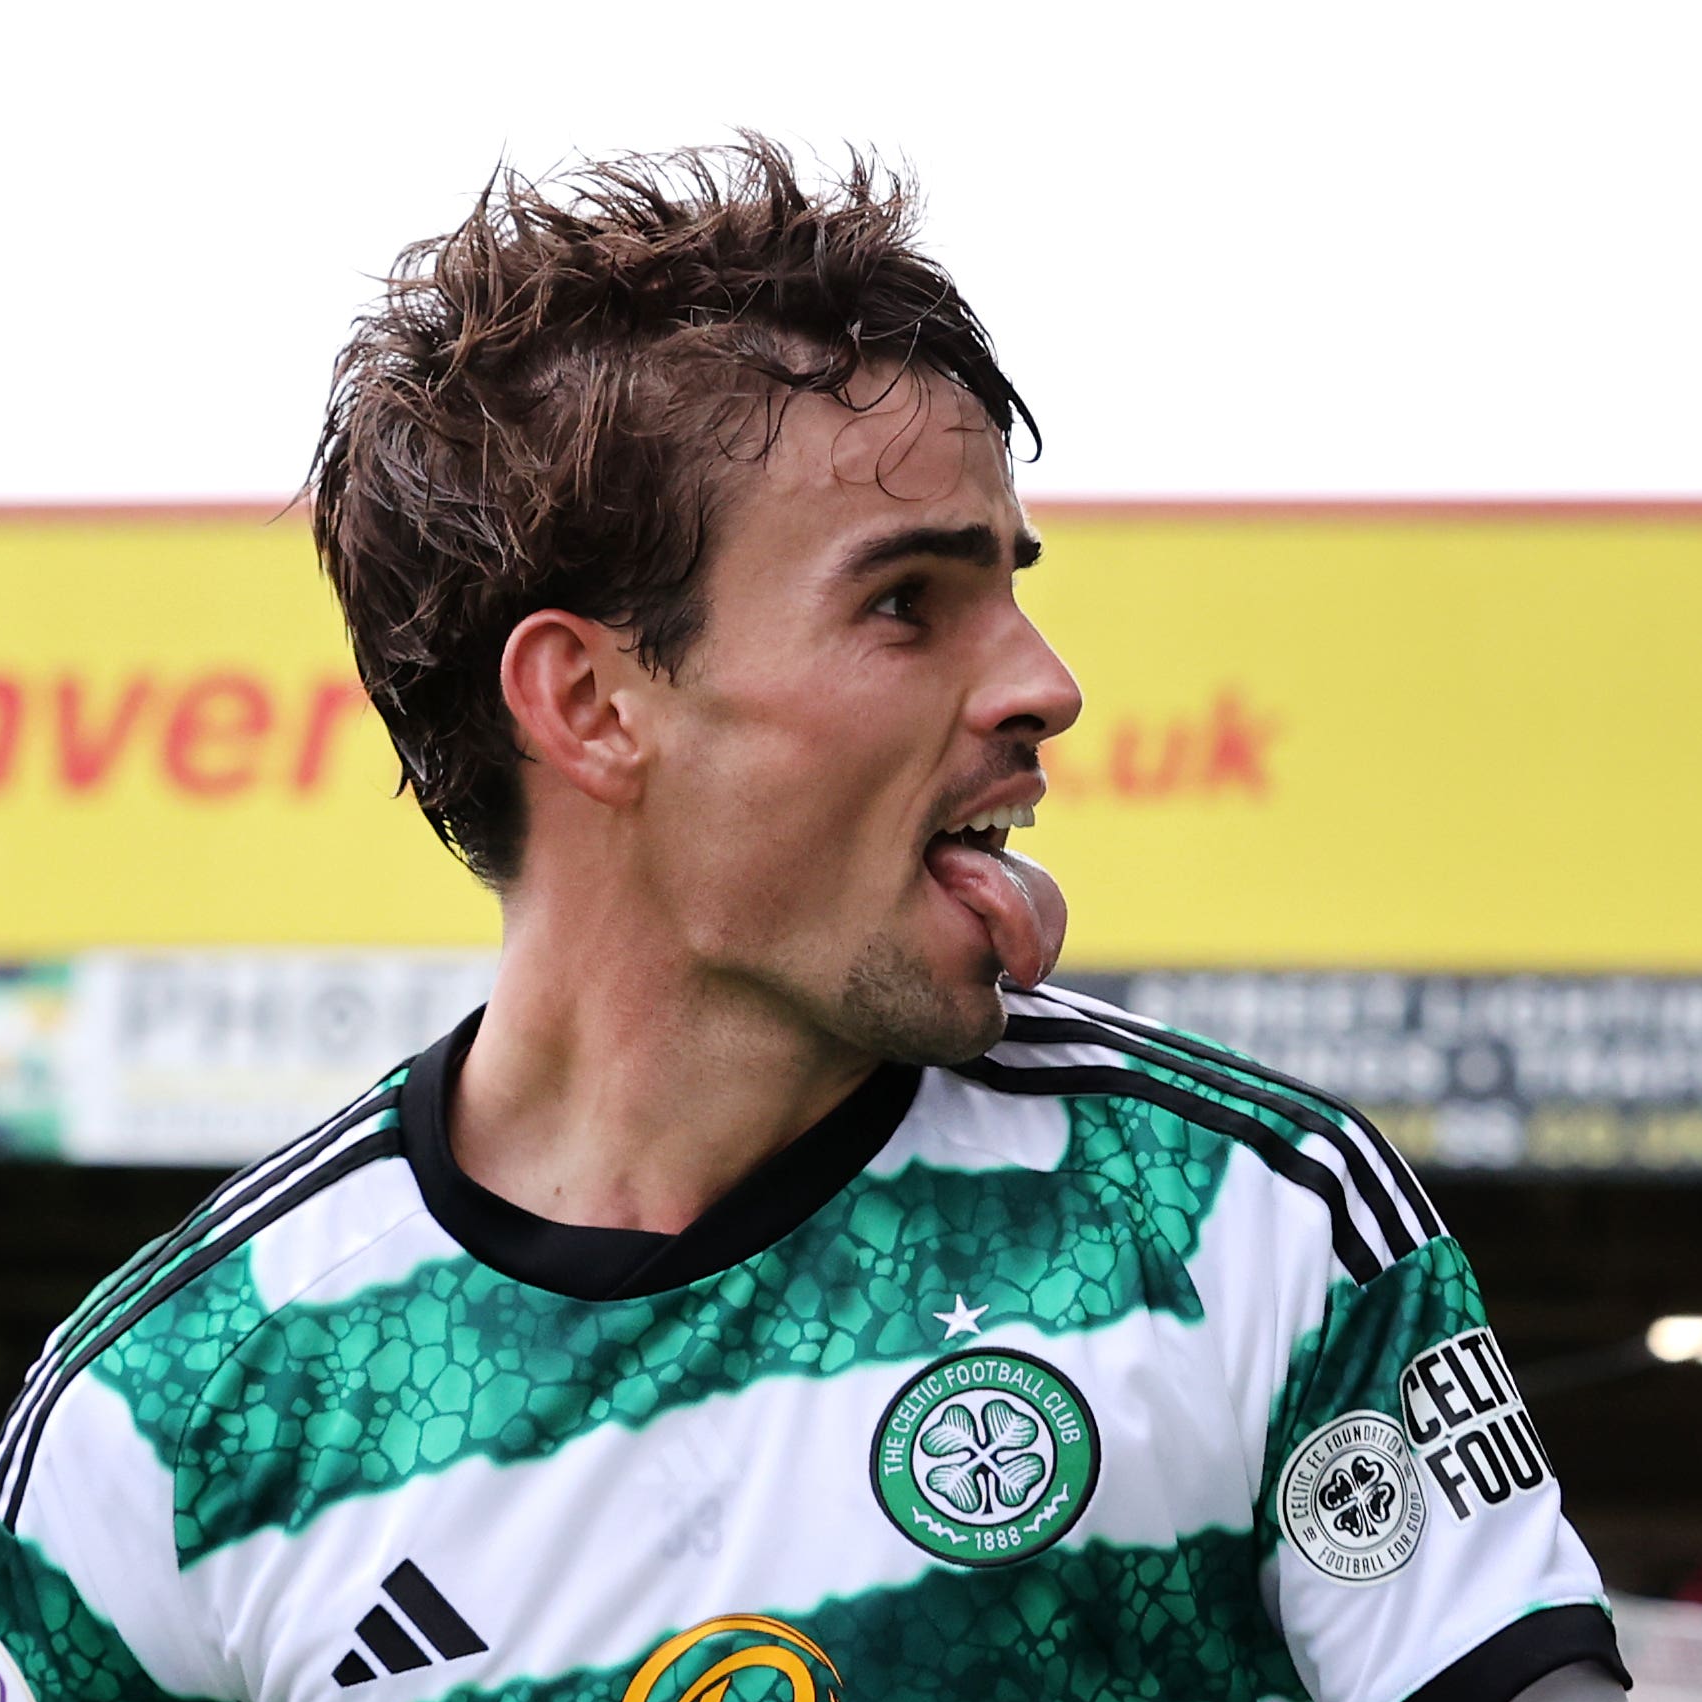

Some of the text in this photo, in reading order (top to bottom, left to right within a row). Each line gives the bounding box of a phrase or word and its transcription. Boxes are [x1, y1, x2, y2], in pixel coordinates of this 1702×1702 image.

[884, 1361, 1082, 1477] THE CELTIC FOOTBALL CLUB
[1291, 1472, 1314, 1520] CELTIC
[1306, 1450, 1326, 1470] FC
[975, 1525, 1022, 1552] 1888
[1318, 1546, 1386, 1575] FOOTBALL
[1387, 1533, 1414, 1562] FOR
